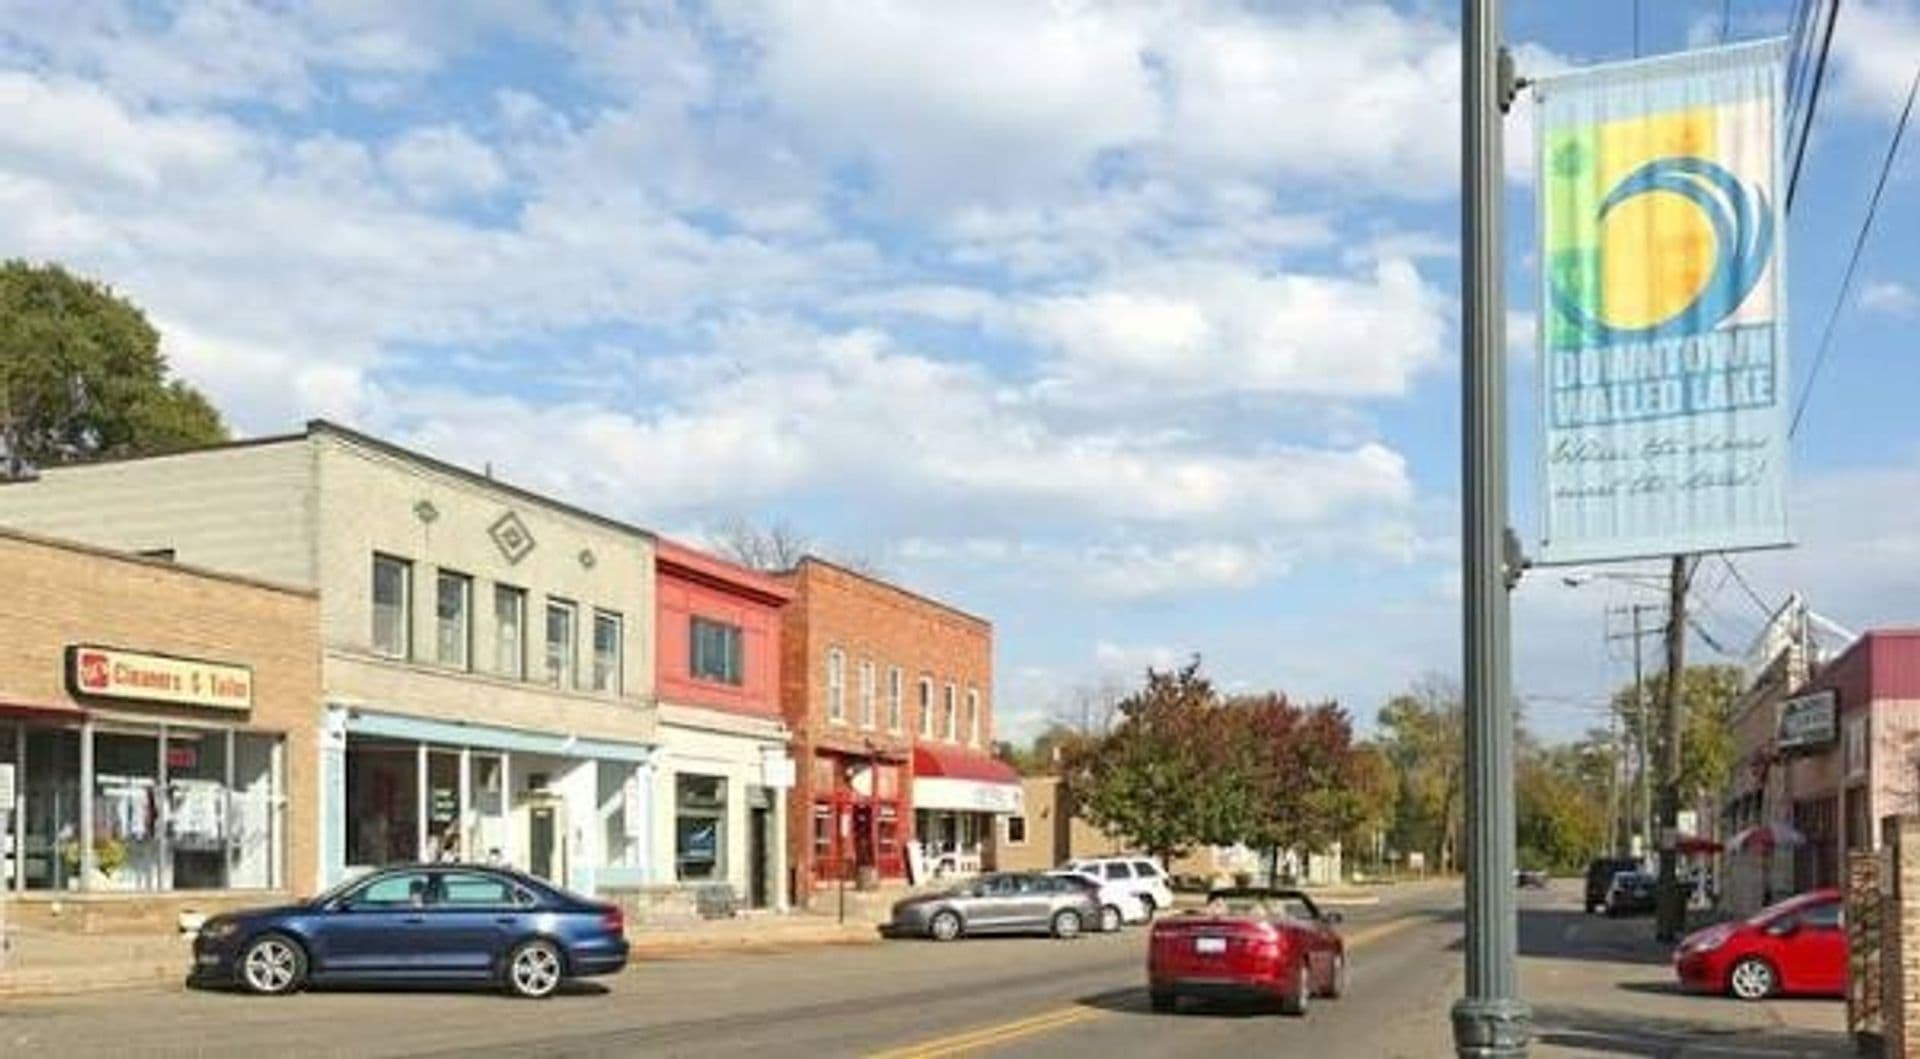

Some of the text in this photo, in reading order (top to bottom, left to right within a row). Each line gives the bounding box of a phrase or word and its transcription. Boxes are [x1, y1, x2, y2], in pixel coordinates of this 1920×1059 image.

[1554, 328, 1771, 389] DOWNTOWN
[1554, 369, 1771, 426] WALLED LAKE
